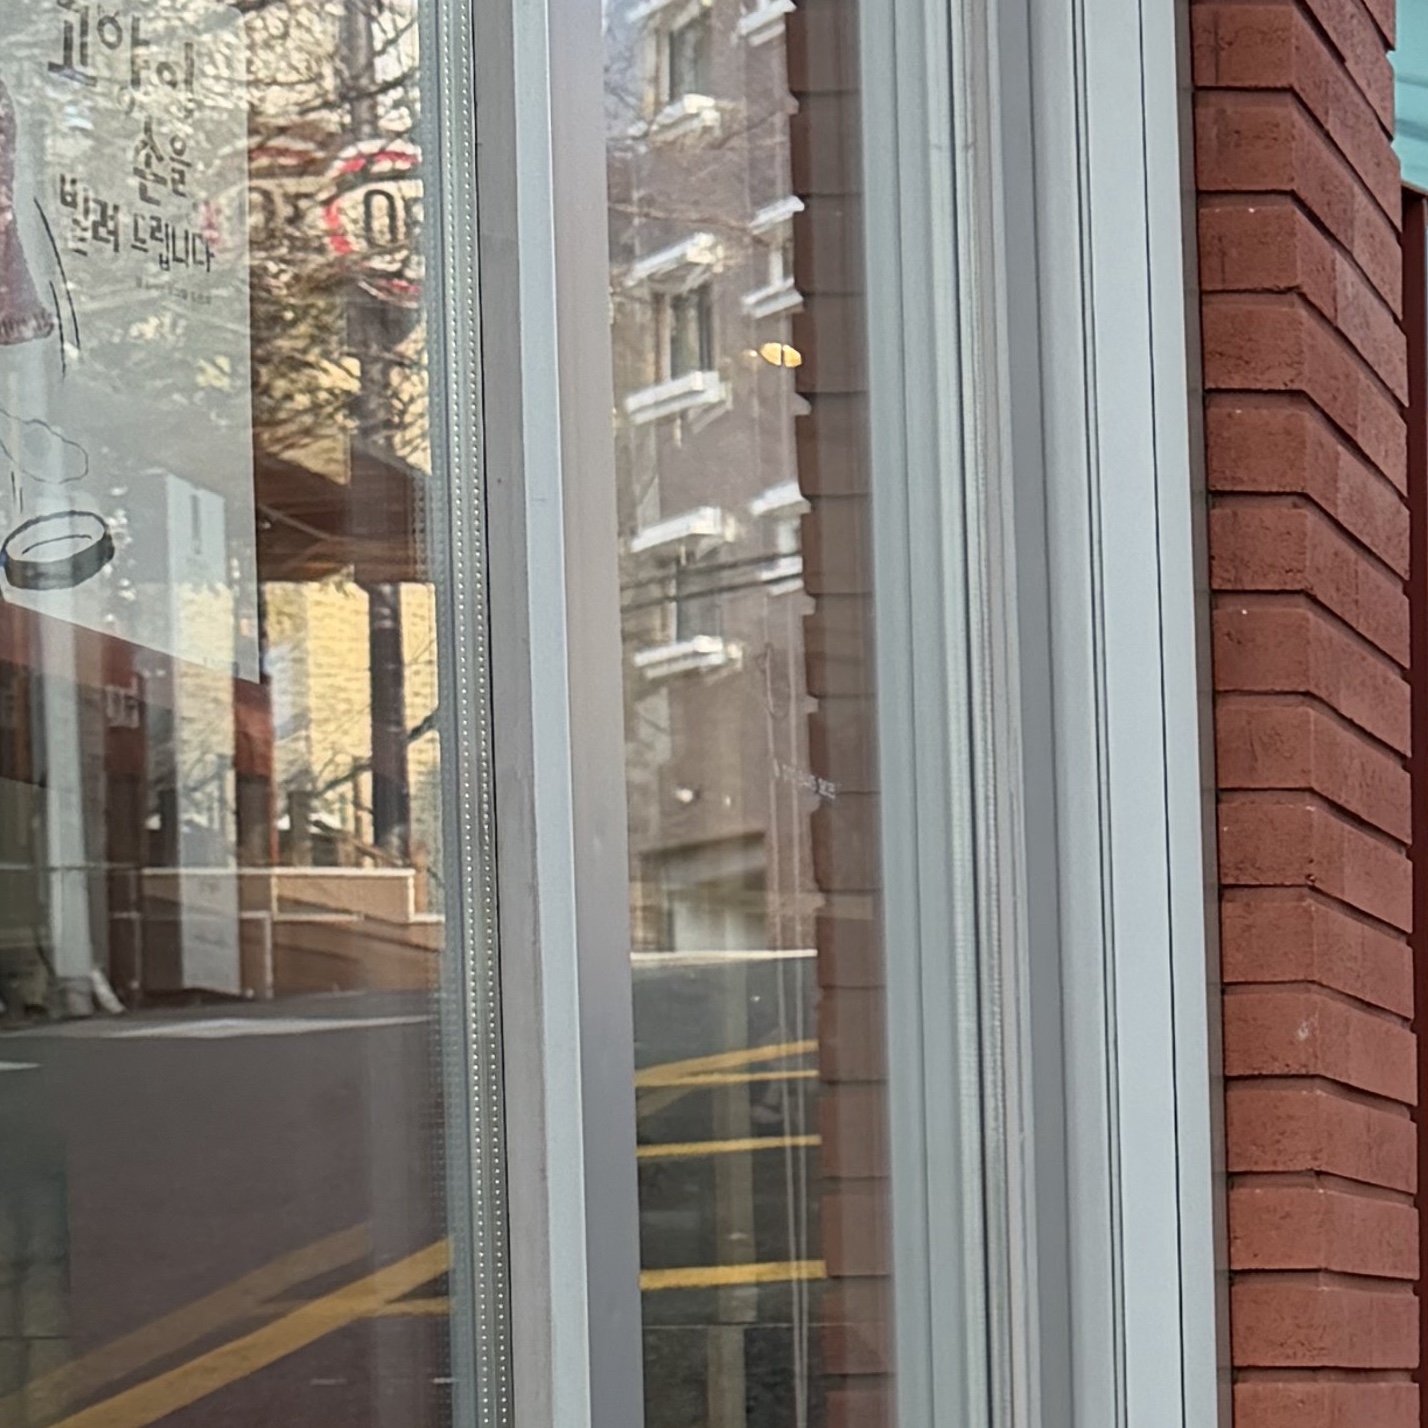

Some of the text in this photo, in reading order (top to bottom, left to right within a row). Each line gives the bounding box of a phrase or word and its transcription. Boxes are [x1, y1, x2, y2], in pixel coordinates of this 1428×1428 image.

[132, 115, 194, 207] 손을
[59, 173, 215, 273] 빌려 드립니다
